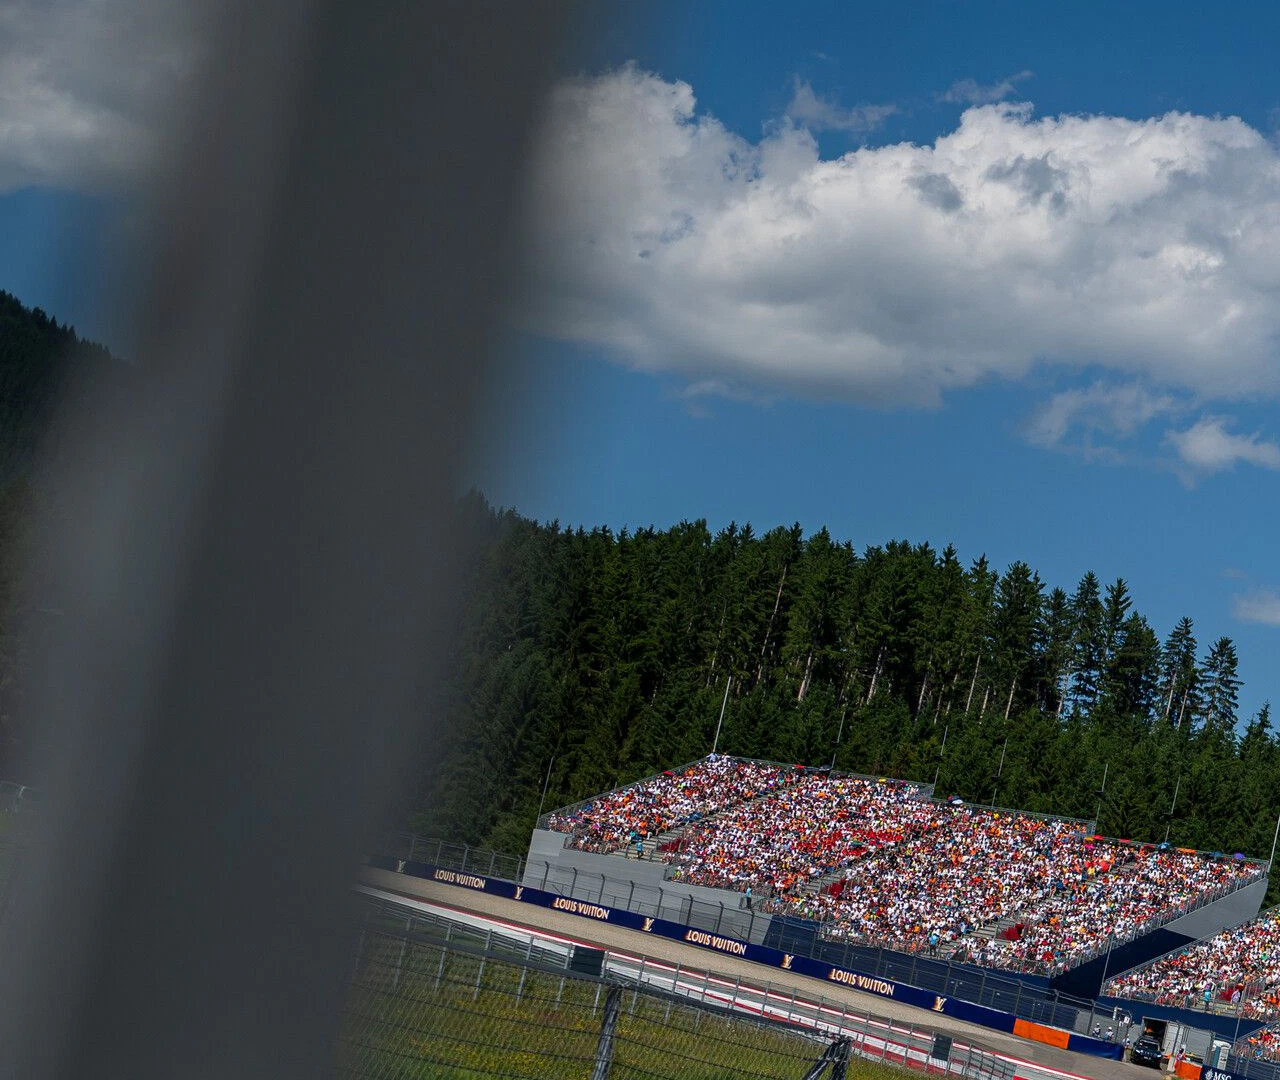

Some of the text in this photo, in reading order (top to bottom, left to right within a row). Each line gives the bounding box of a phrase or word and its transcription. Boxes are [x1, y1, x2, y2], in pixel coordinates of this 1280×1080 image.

[435, 870, 486, 888] LOUIS VUITTON
[554, 898, 610, 919] LOUIS VUITTON
[687, 930, 747, 955] LOUIS VUITTON
[830, 968, 894, 996] LOUIS VUITTON
